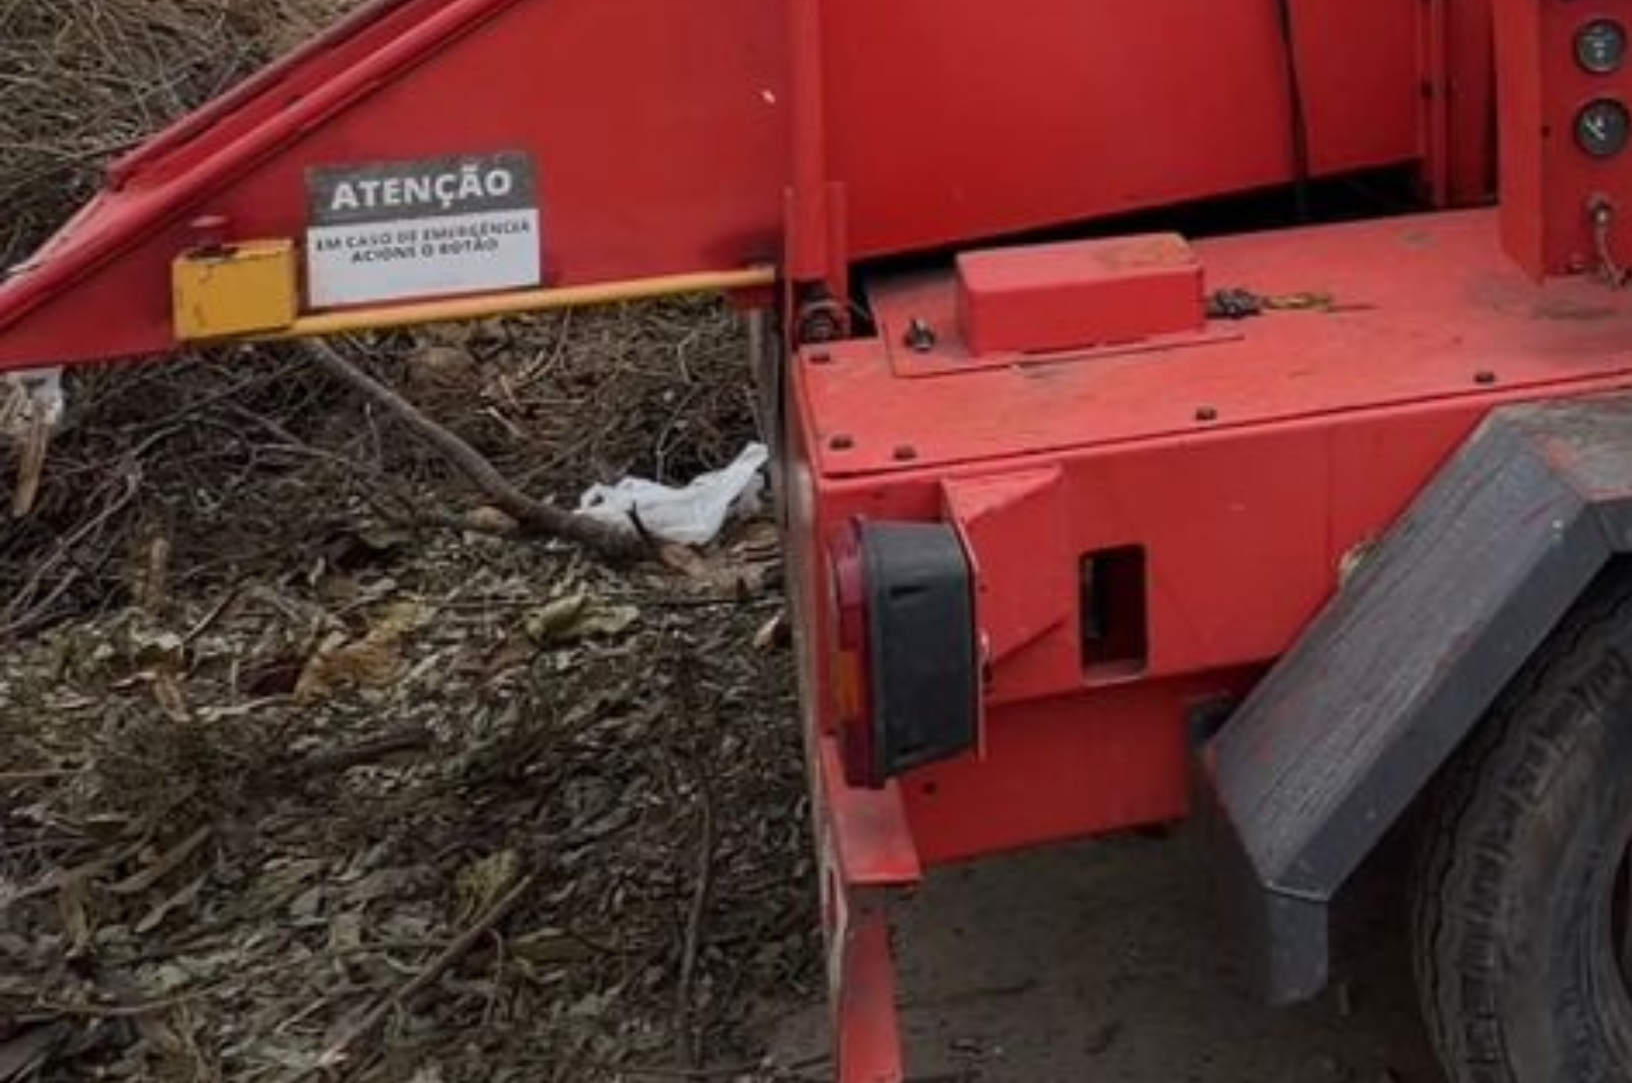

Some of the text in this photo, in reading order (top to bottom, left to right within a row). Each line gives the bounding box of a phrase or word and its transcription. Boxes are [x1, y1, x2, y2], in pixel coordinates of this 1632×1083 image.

[331, 163, 514, 210] ATENÇÃO
[316, 236, 342, 252] EM
[346, 231, 392, 248] CASO
[397, 229, 418, 244] DE
[421, 242, 434, 257] O
[439, 235, 500, 255] BOTÃO
